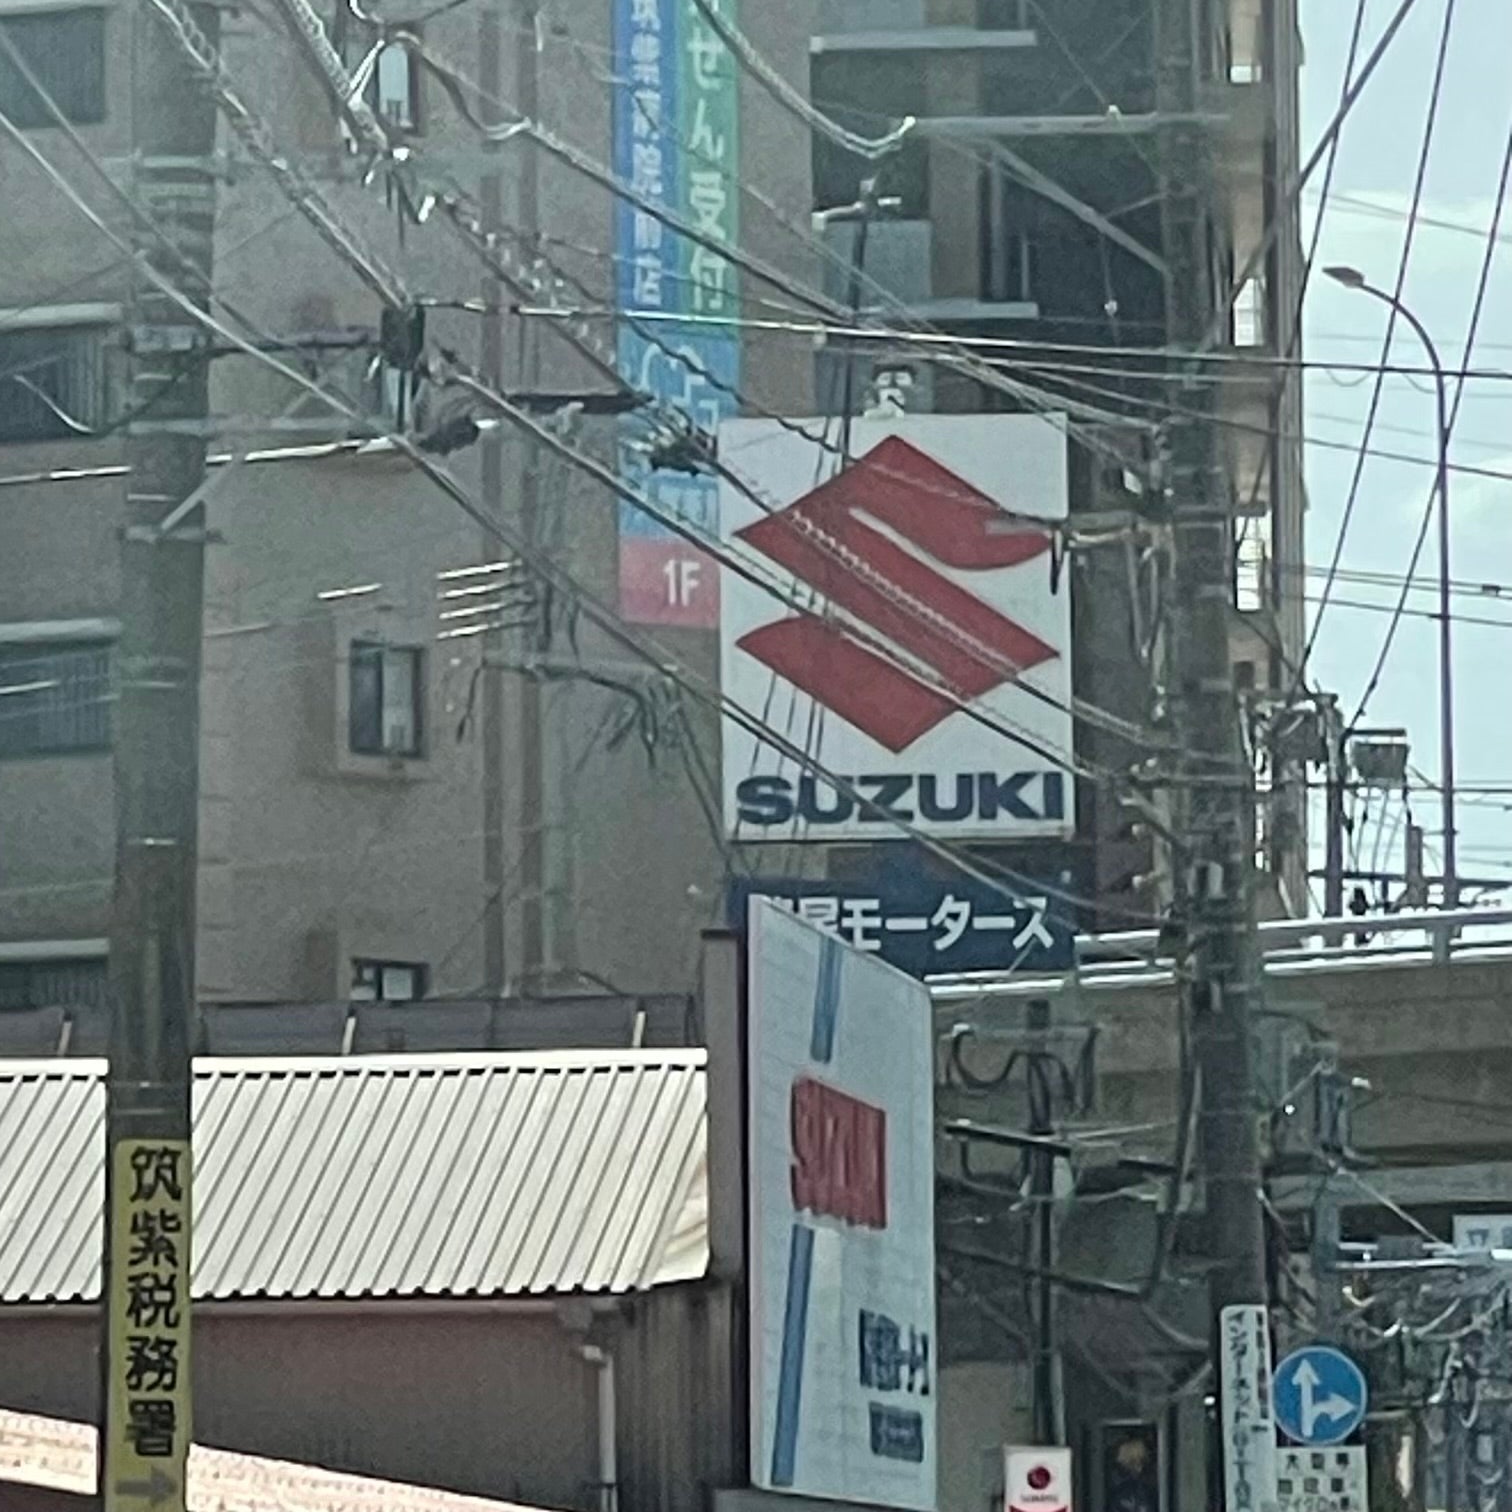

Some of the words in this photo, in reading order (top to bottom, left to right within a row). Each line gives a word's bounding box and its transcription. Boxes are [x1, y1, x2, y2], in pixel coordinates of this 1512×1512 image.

[663, 559, 701, 607] 1F
[736, 771, 1064, 825] SUZUKI
[125, 1146, 184, 1458] 筑紫税務署
